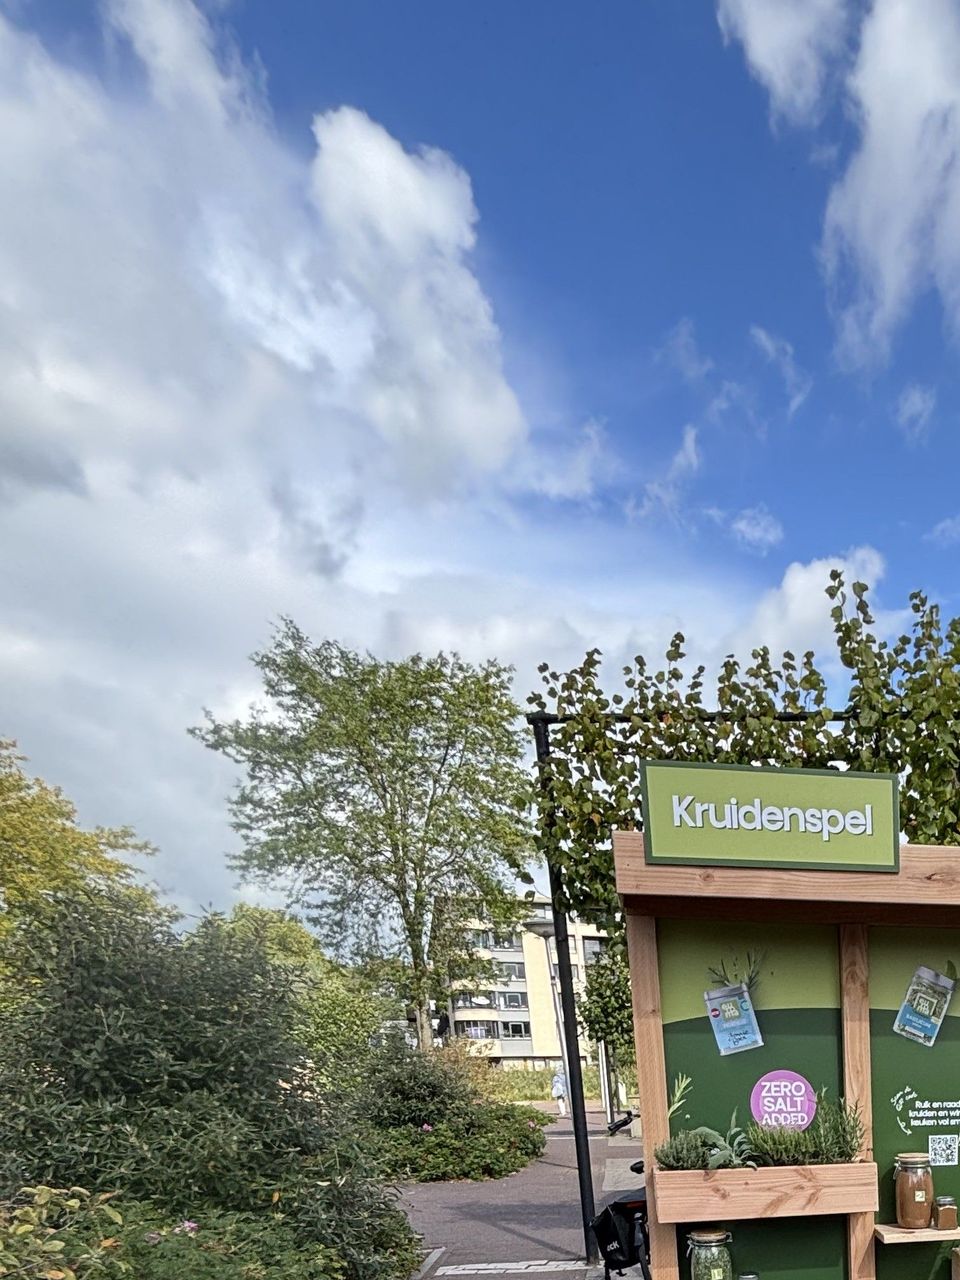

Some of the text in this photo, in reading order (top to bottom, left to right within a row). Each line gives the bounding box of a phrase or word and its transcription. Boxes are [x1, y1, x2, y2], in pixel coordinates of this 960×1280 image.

[672, 794, 873, 842] Kruidenspel
[761, 1081, 805, 1096] ZERO
[763, 1097, 804, 1112] SALT
[915, 1100, 931, 1109] Ruik
[943, 1100, 960, 1108] raad
[761, 1112, 808, 1125] ADDED
[908, 1109, 937, 1118] kruiden
[938, 1109, 948, 1117] en
[910, 1118, 937, 1127] keuken
[938, 1117, 949, 1126] vol
